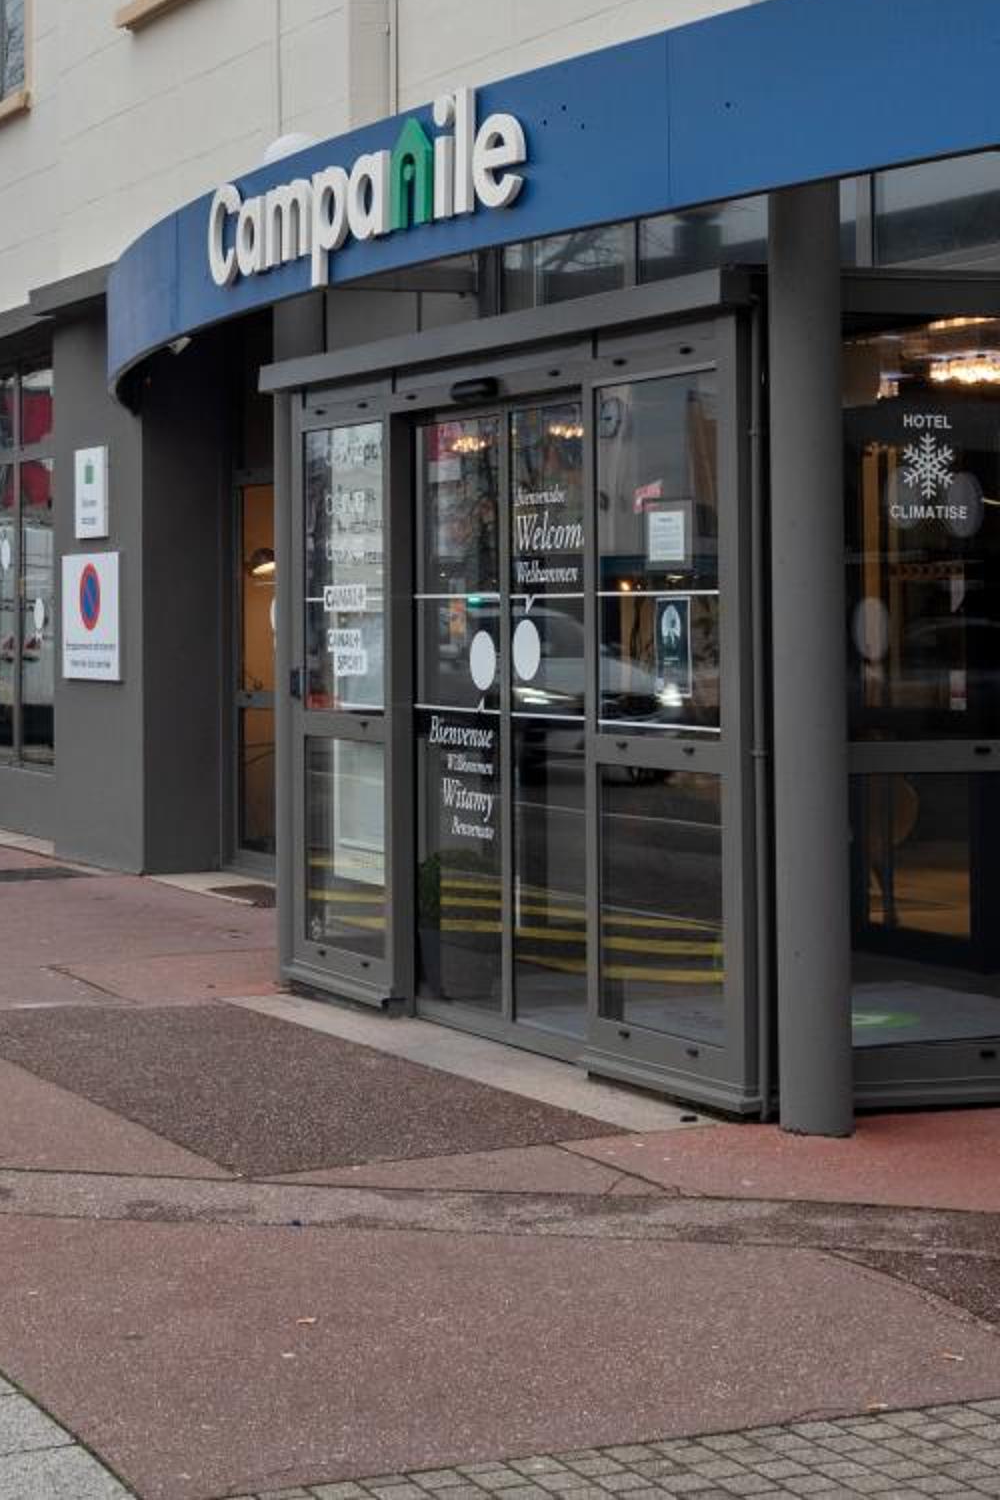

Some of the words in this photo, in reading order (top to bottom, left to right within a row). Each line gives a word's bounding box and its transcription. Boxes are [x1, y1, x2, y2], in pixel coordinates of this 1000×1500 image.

[208, 84, 527, 287] Campanile
[903, 414, 953, 429] HOTEL
[890, 505, 968, 519] CLIMATISE
[517, 510, 585, 551] Welcom
[429, 715, 493, 748] Bienvenue
